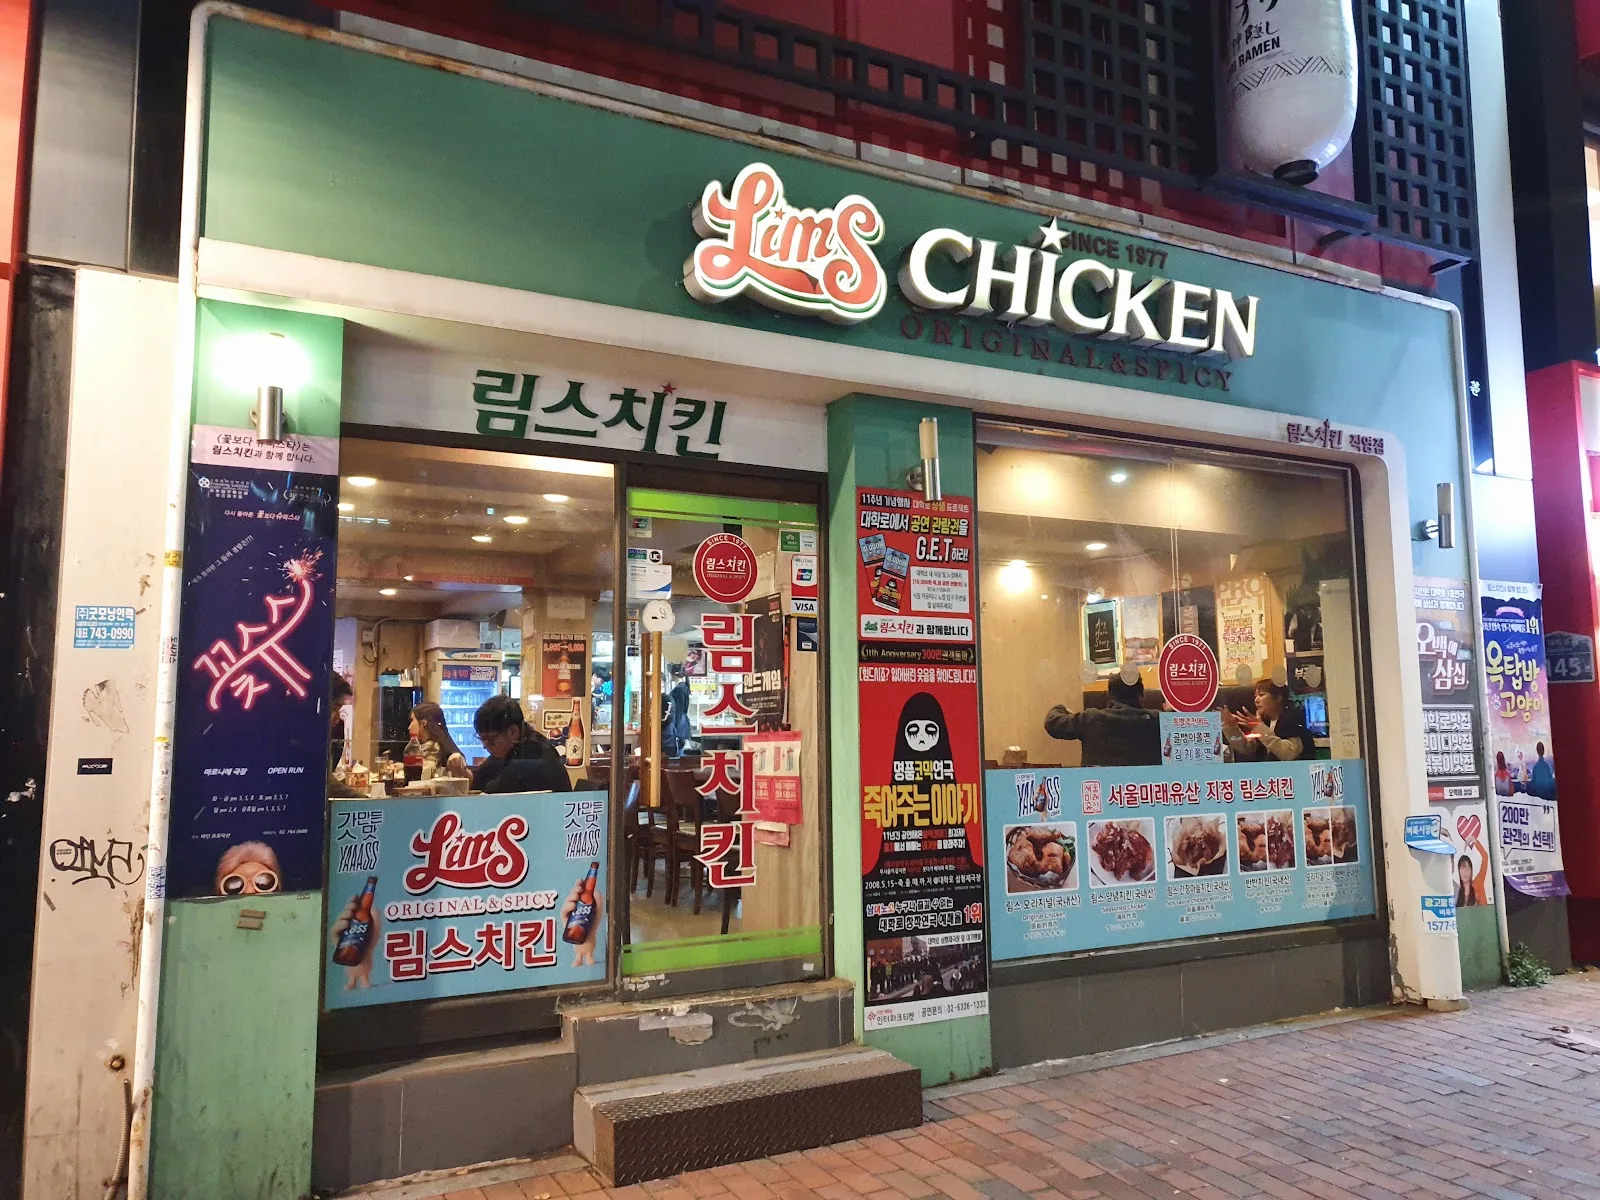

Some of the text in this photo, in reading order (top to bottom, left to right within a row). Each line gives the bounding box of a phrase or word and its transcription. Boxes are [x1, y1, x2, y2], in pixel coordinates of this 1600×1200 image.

[1238, 36, 1280, 67] RAMEN
[1124, 240, 1168, 269] 1977
[472, 369, 728, 461] 림스치킨
[1286, 418, 1385, 455] 림스치킨 직영점
[212, 445, 264, 458] 림스치킨과
[265, 450, 283, 461] 함께
[861, 493, 882, 507] 11주년
[860, 511, 969, 536] 대학로에서 공연 관람권을
[706, 535, 728, 546] SINCE
[706, 556, 747, 572] 림스치킨
[795, 602, 814, 612] VISA
[90, 627, 133, 640] 743-0990
[880, 620, 969, 637] 림스치킨 과 함께합니다
[1526, 616, 1540, 635] 1위
[1168, 635, 1188, 651] SINCE
[1416, 621, 1458, 657] 오백에
[881, 647, 922, 661] Anniversary
[917, 668, 935, 683] 웃음을
[1169, 661, 1207, 677] 림스치킨
[1431, 659, 1467, 691] 삼십
[1486, 640, 1541, 692] 옥탑방
[744, 669, 782, 694] 엔드게임
[1500, 691, 1544, 723] 고양이
[692, 613, 764, 889] 림스치킨
[267, 766, 304, 775] OPEN RUN
[893, 760, 954, 781] 명품코믹연극
[1108, 776, 1294, 808] 서울미래유산 지정 림스치킨
[1501, 805, 1529, 826] 200만
[565, 829, 601, 859] YAAASS
[1502, 828, 1554, 850] 관객의 선택!
[338, 841, 380, 873] YAAASS
[387, 893, 555, 918] ORIGINAL & SPICY
[1005, 895, 1081, 912] 림스 오리지널(국내산)
[1091, 888, 1157, 904] 림스 양념치킨(국내산)
[879, 917, 904, 933] 대학로
[905, 913, 938, 931] 창작연극
[964, 902, 982, 924] 1위
[1022, 913, 1044, 922] Original
[387, 919, 556, 980] 림스치킨
[877, 1012, 915, 1026] 인터파크티켓
[921, 1003, 943, 1018] 공연문의
